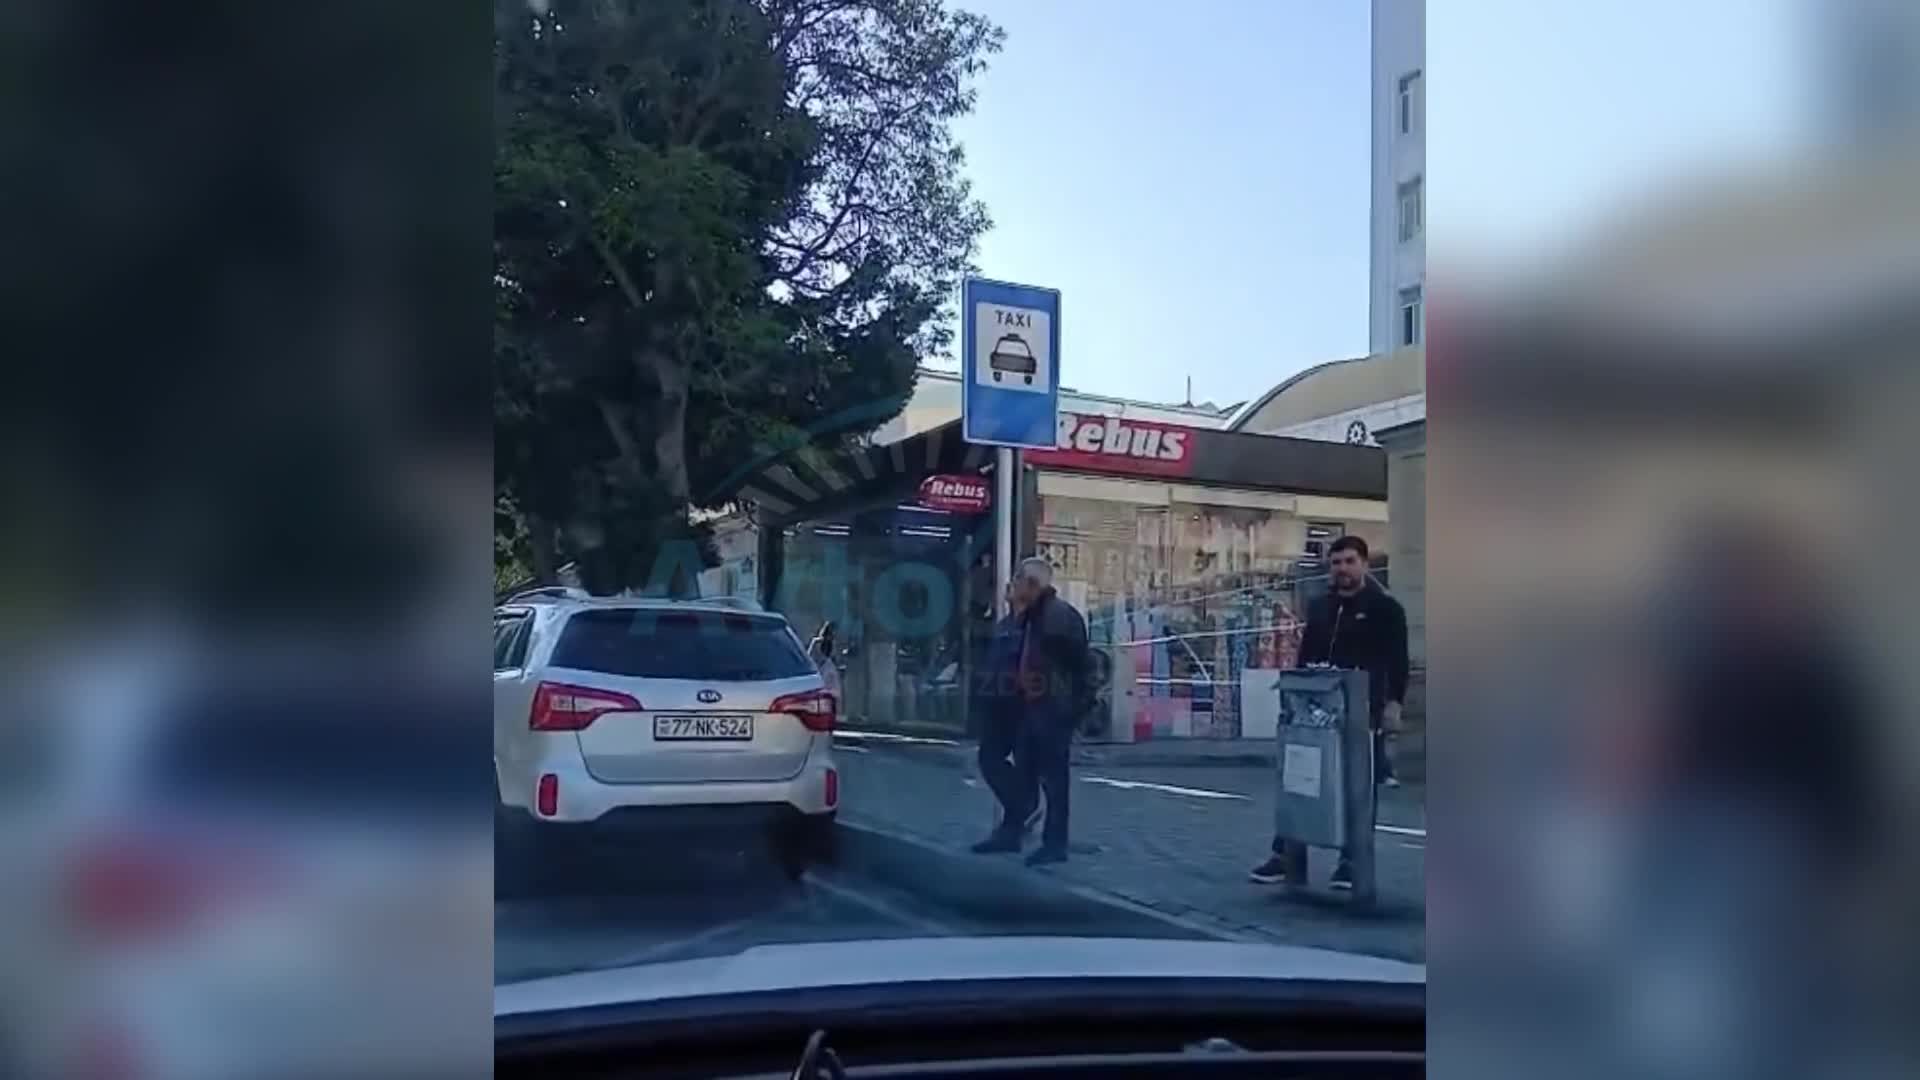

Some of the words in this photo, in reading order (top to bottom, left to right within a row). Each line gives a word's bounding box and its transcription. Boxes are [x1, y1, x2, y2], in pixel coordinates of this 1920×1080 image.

[994, 309, 1032, 328] TAXI
[1056, 414, 1187, 461] Rebus
[930, 480, 985, 498] Rebus
[699, 692, 720, 701] KIA
